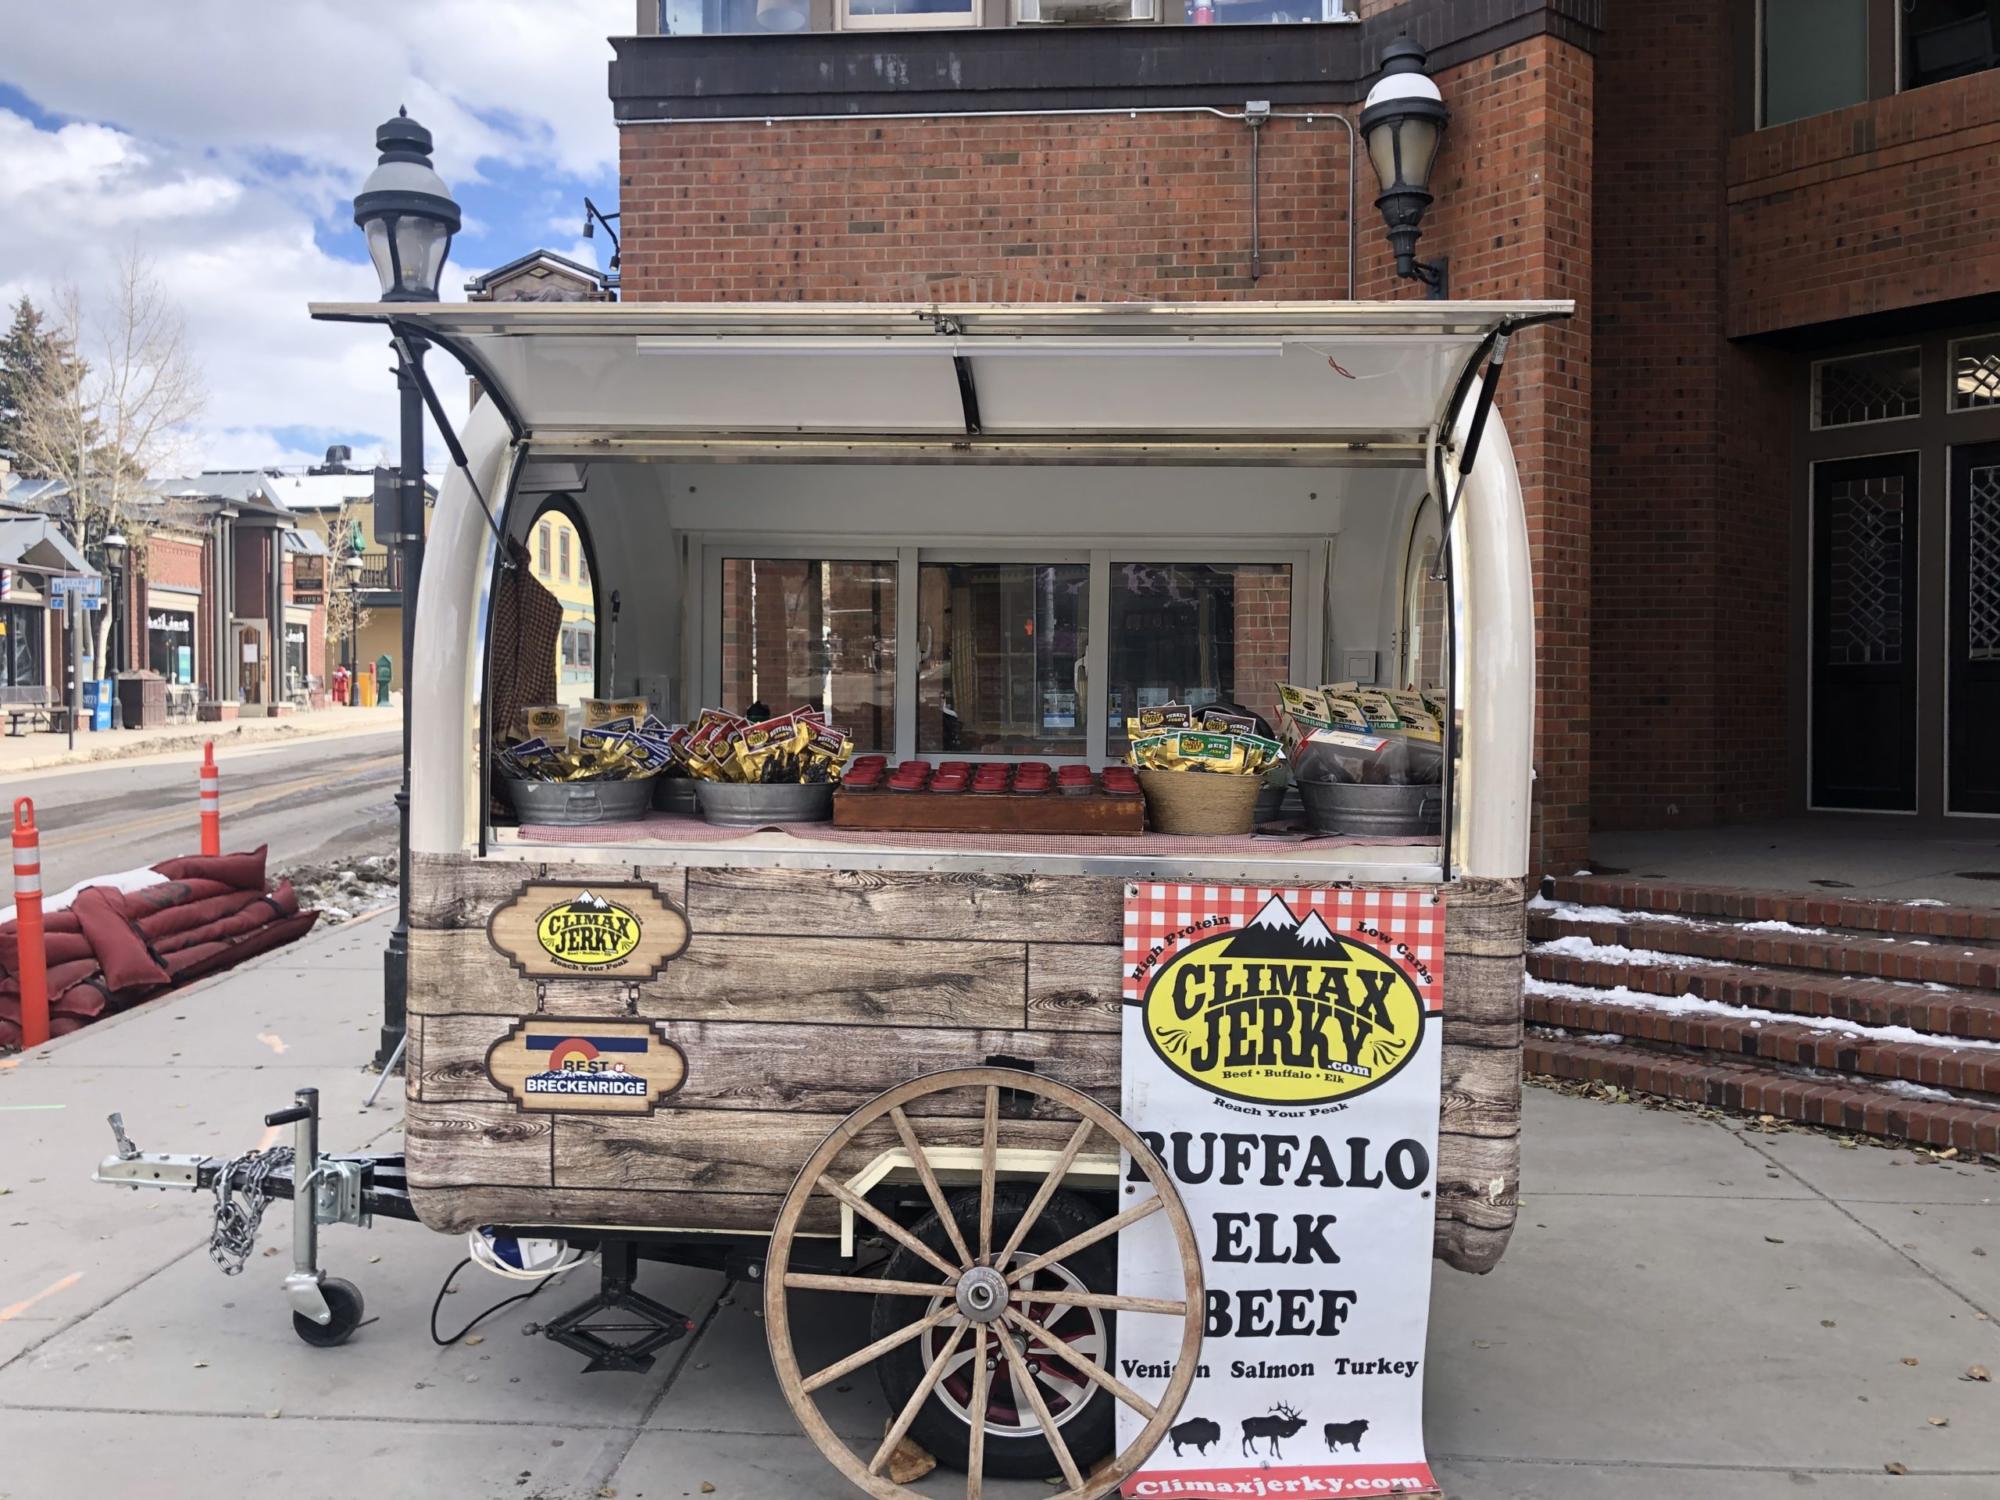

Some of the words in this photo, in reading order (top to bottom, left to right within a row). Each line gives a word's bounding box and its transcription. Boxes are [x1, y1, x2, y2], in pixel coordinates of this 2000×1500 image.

[548, 913, 630, 940] CLIMAX
[555, 926, 622, 953] JERKY
[1132, 941, 1165, 982] High
[1164, 913, 1231, 946] Protein
[1356, 920, 1393, 945] Low
[1396, 941, 1434, 985] Carbs
[550, 956, 579, 970] Reach
[606, 958, 629, 969] Peak
[1171, 962, 1396, 1035] CLIMAX
[1190, 996, 1374, 1075] JERKY
[1327, 1060, 1371, 1076] .com
[563, 1060, 609, 1072] BEST
[1222, 1069, 1254, 1079] Beef
[1264, 1069, 1312, 1080] Buffalo
[1324, 1073, 1345, 1084] Elk
[526, 1078, 646, 1095] BRECKENRIDGE
[1212, 1097, 1262, 1117] Reach
[1265, 1109, 1307, 1118] Your
[1310, 1102, 1351, 1117] Peak
[1126, 1130, 1430, 1190] BUFFALO
[1211, 1211, 1341, 1264] ELK
[1203, 1289, 1357, 1338] BEEF
[1120, 1359, 1211, 1378] Venin
[1230, 1360, 1315, 1379] Salmon
[1334, 1357, 1419, 1378] Turkey
[1134, 1473, 1422, 1496] Climaxjerky.com
